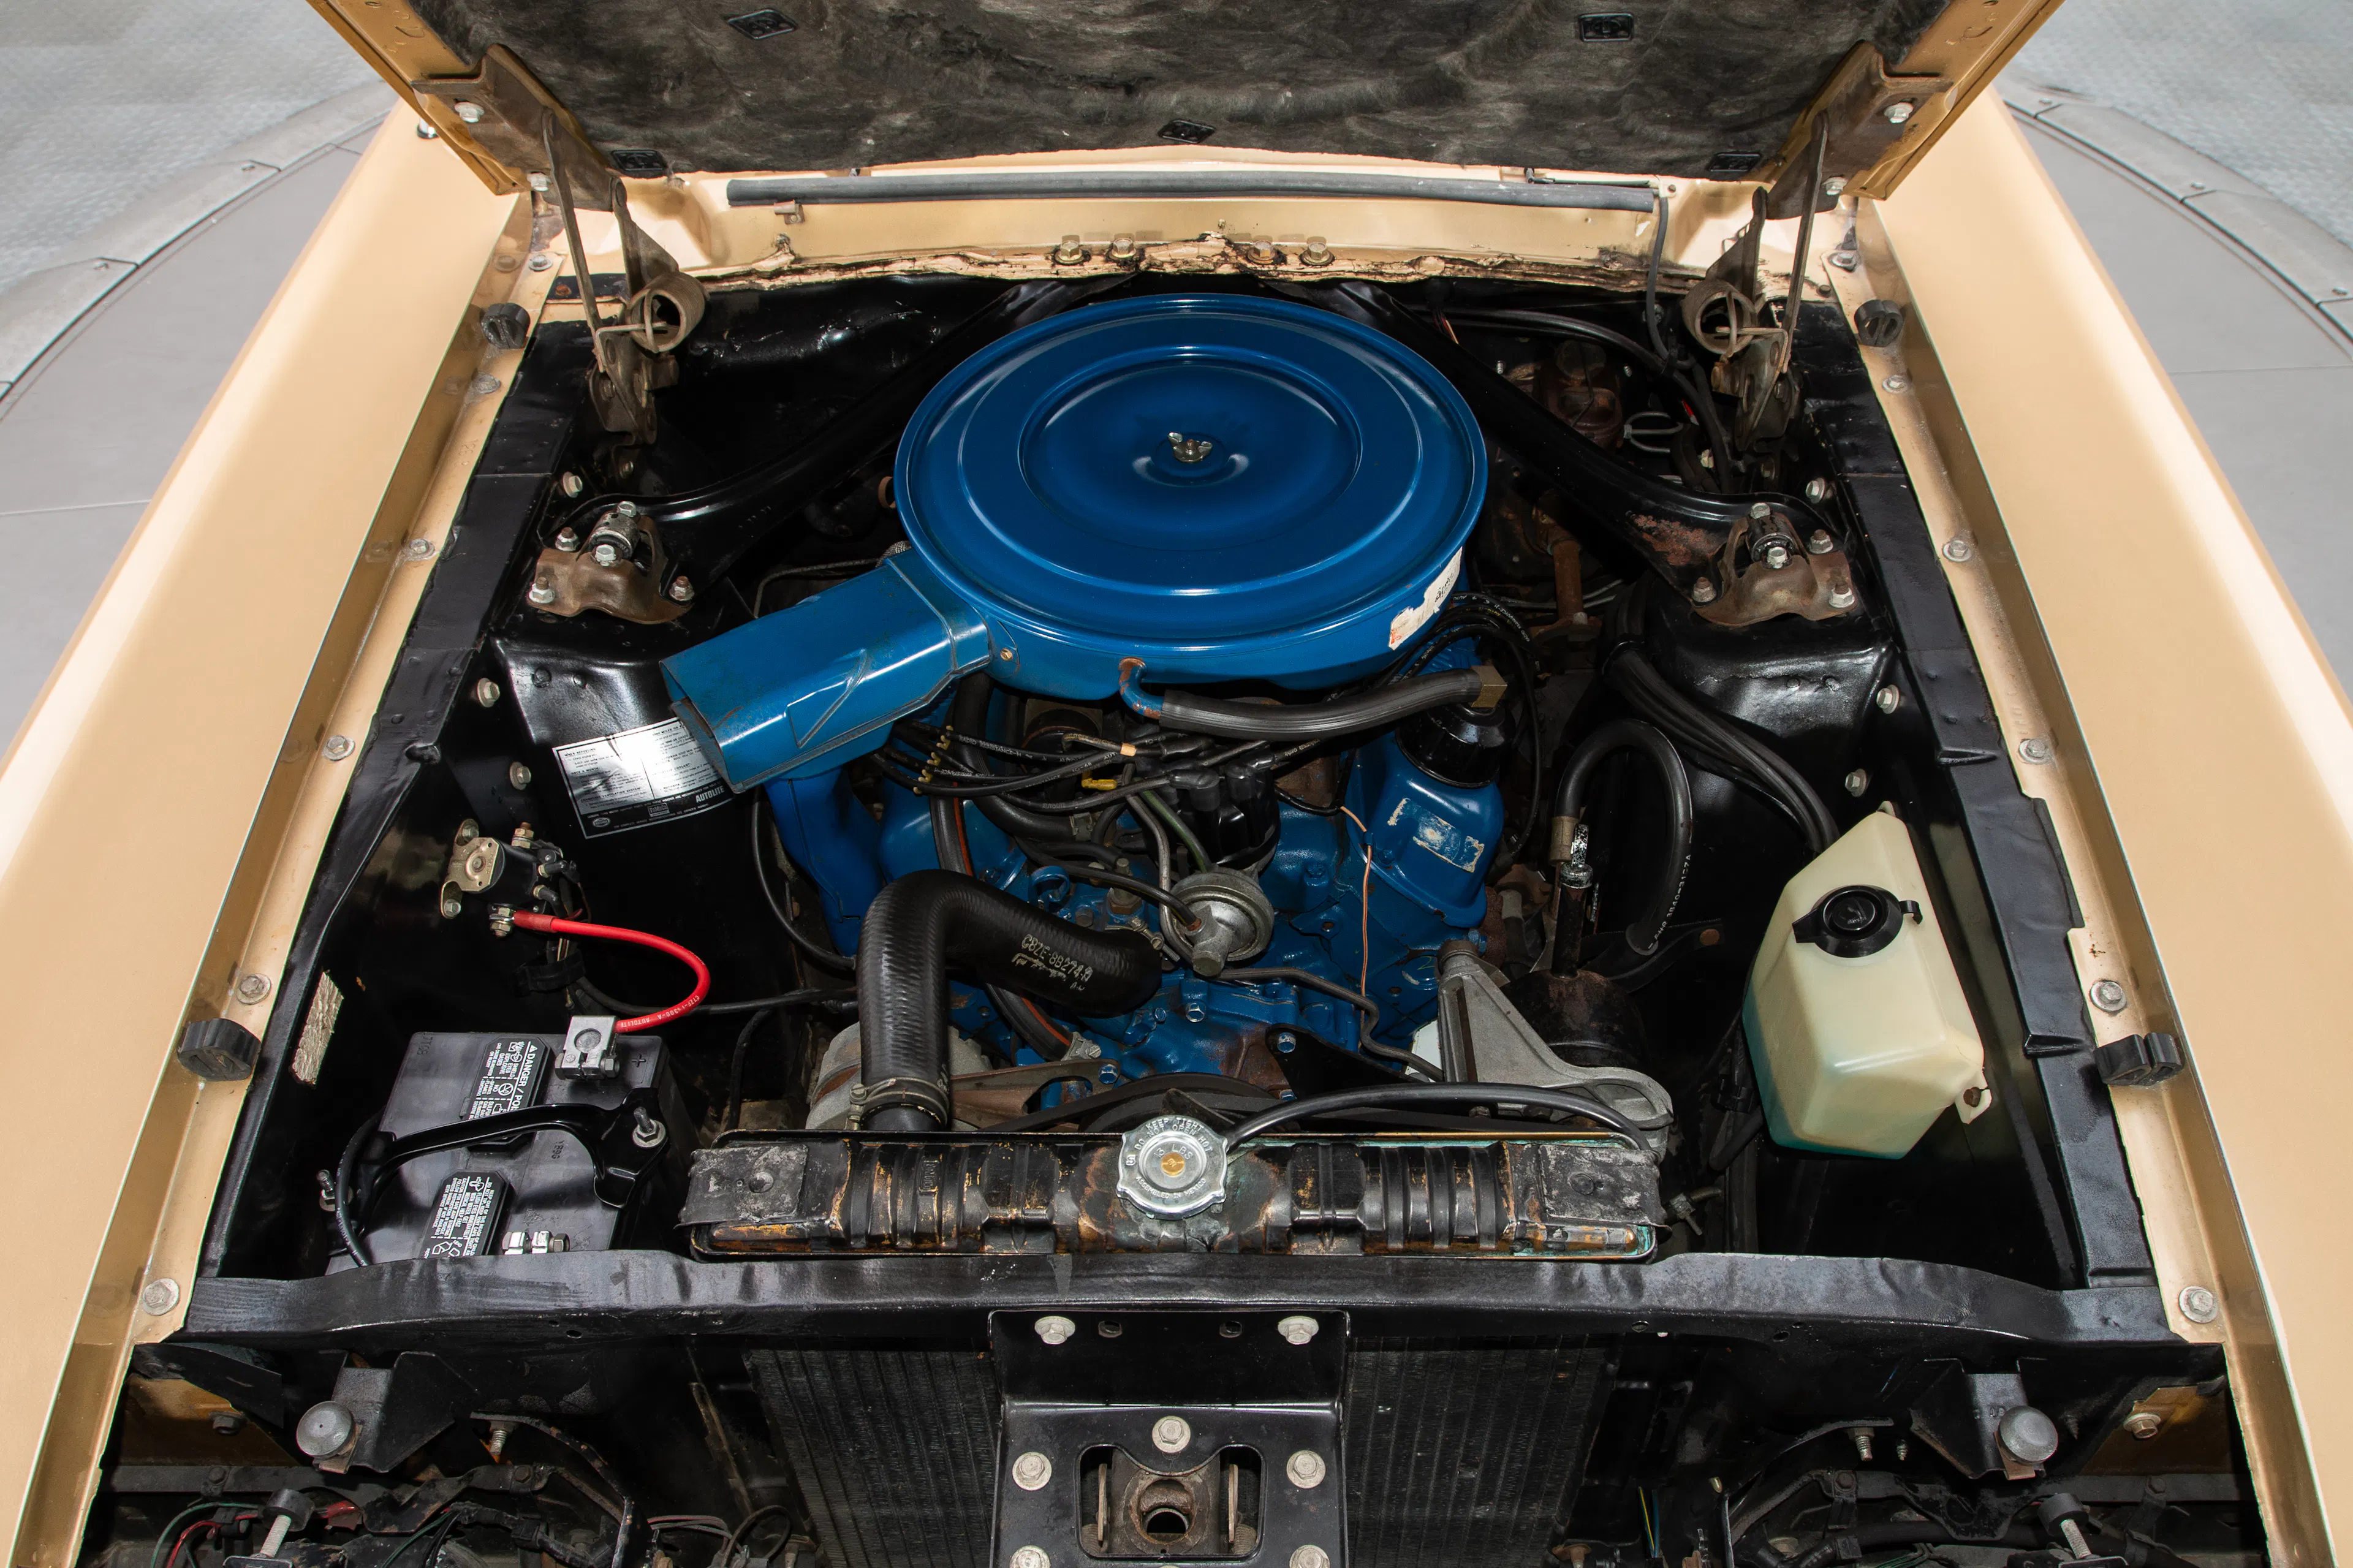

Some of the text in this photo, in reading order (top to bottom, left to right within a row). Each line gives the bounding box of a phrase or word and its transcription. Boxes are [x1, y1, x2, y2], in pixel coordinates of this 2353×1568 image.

[958, 734, 977, 745] RADIO
[695, 786, 725, 803] AUTOLITE
[620, 1017, 650, 1028] AUTOLITE
[496, 1053, 505, 1066] GASES
[499, 1053, 511, 1075] EXPLOSIVE
[509, 1063, 519, 1077] SHIELD
[518, 1053, 536, 1087] DANGER
[1145, 1117, 1205, 1132] KEEP TIGHT
[1134, 1124, 1213, 1152] DO NOT OPEN HOT
[1172, 1144, 1193, 1160] LBS
[1135, 1176, 1170, 1199] ASSEMBLED
[1184, 1178, 1206, 1197] MEXICO
